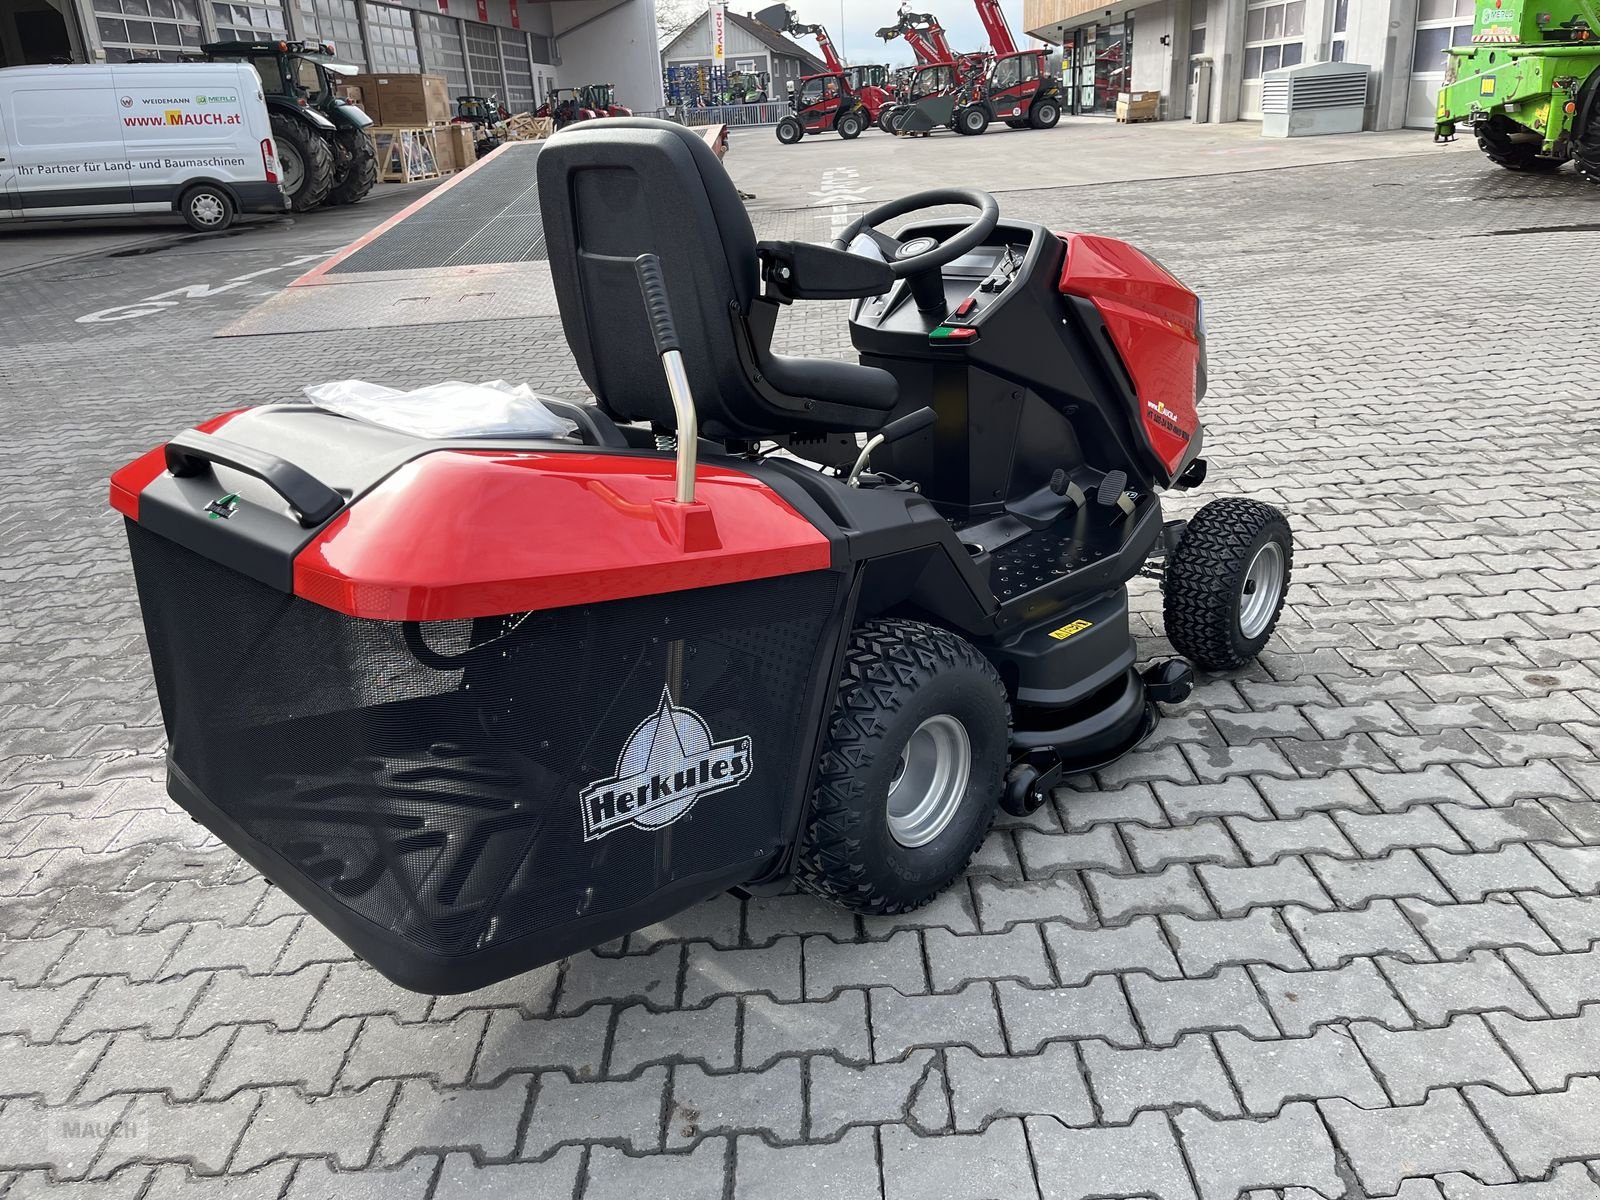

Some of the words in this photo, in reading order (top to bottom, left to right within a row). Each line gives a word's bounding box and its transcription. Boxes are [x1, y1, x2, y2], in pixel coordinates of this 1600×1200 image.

[123, 113, 240, 127] www.MAUCH.at
[17, 166, 34, 176] Ihr
[37, 164, 81, 175] Partner
[83, 163, 101, 172] für
[104, 160, 136, 171] Land-
[139, 159, 162, 170] und
[164, 156, 245, 169] Baumaschinen
[589, 755, 746, 825] Herkules
